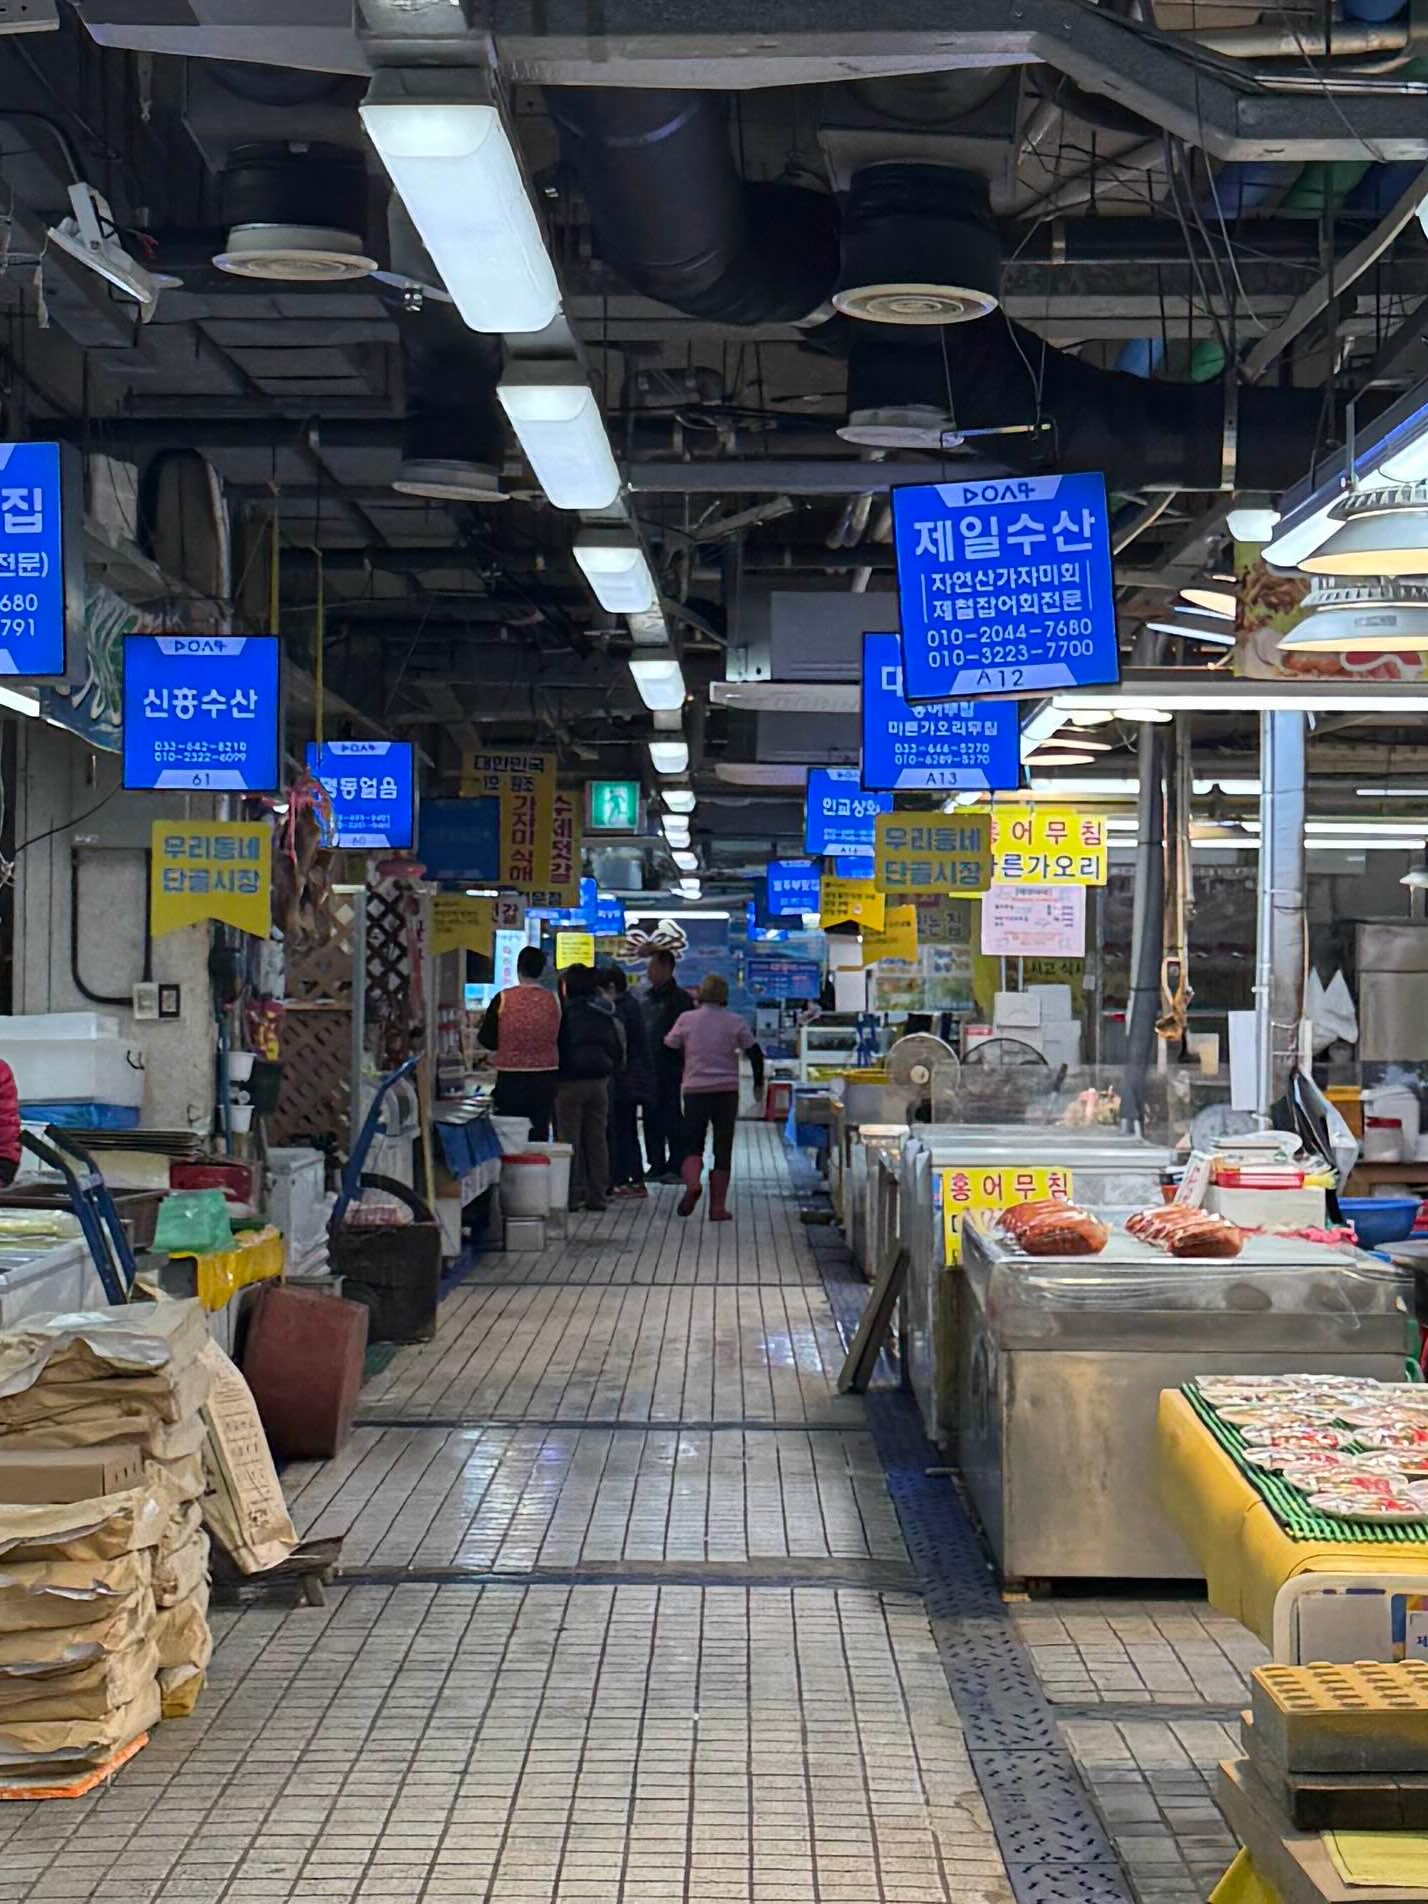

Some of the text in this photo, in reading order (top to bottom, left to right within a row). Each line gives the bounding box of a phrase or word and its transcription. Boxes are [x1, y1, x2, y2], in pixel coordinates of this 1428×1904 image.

[913, 508, 1096, 563] 제일수산
[931, 562, 1080, 594] 자연산가자미회
[933, 588, 1083, 622] 제철잡어회전문
[927, 617, 1093, 648] 010-2044-7680
[929, 638, 1094, 669] 010-3223-7700
[977, 668, 1024, 689] A12
[143, 687, 259, 720] 신흥수산
[192, 772, 211, 786] 61
[926, 772, 958, 786] A13
[164, 835, 261, 860] 우리동네
[884, 826, 981, 853] 우리동네
[163, 867, 261, 894] 단골시장
[885, 859, 981, 887] 단골시장
